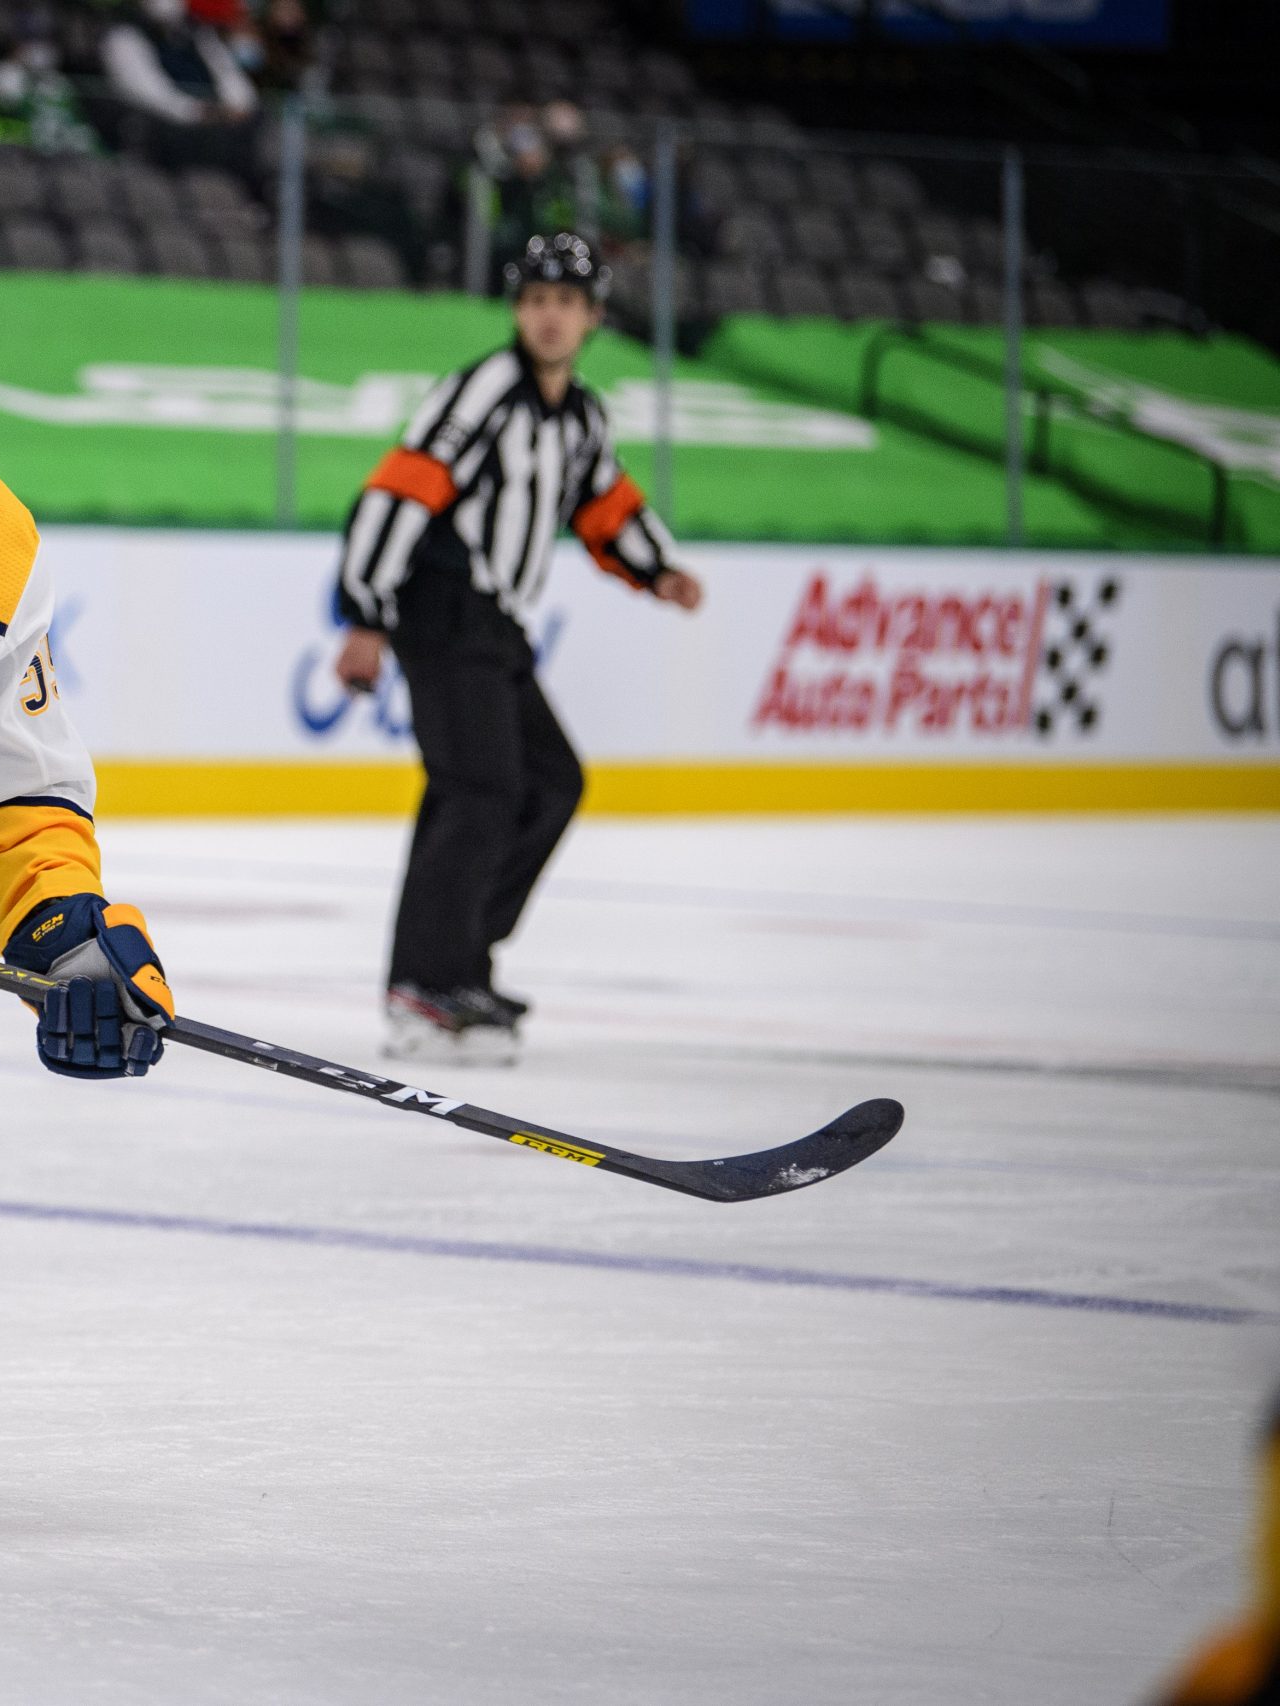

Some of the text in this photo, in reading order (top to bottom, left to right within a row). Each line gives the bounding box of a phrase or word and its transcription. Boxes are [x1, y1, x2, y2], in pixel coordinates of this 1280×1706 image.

[786, 570, 1023, 658] Advance
[19, 633, 60, 717] 5
[751, 662, 874, 733] Auto
[31, 913, 64, 938] CCM
